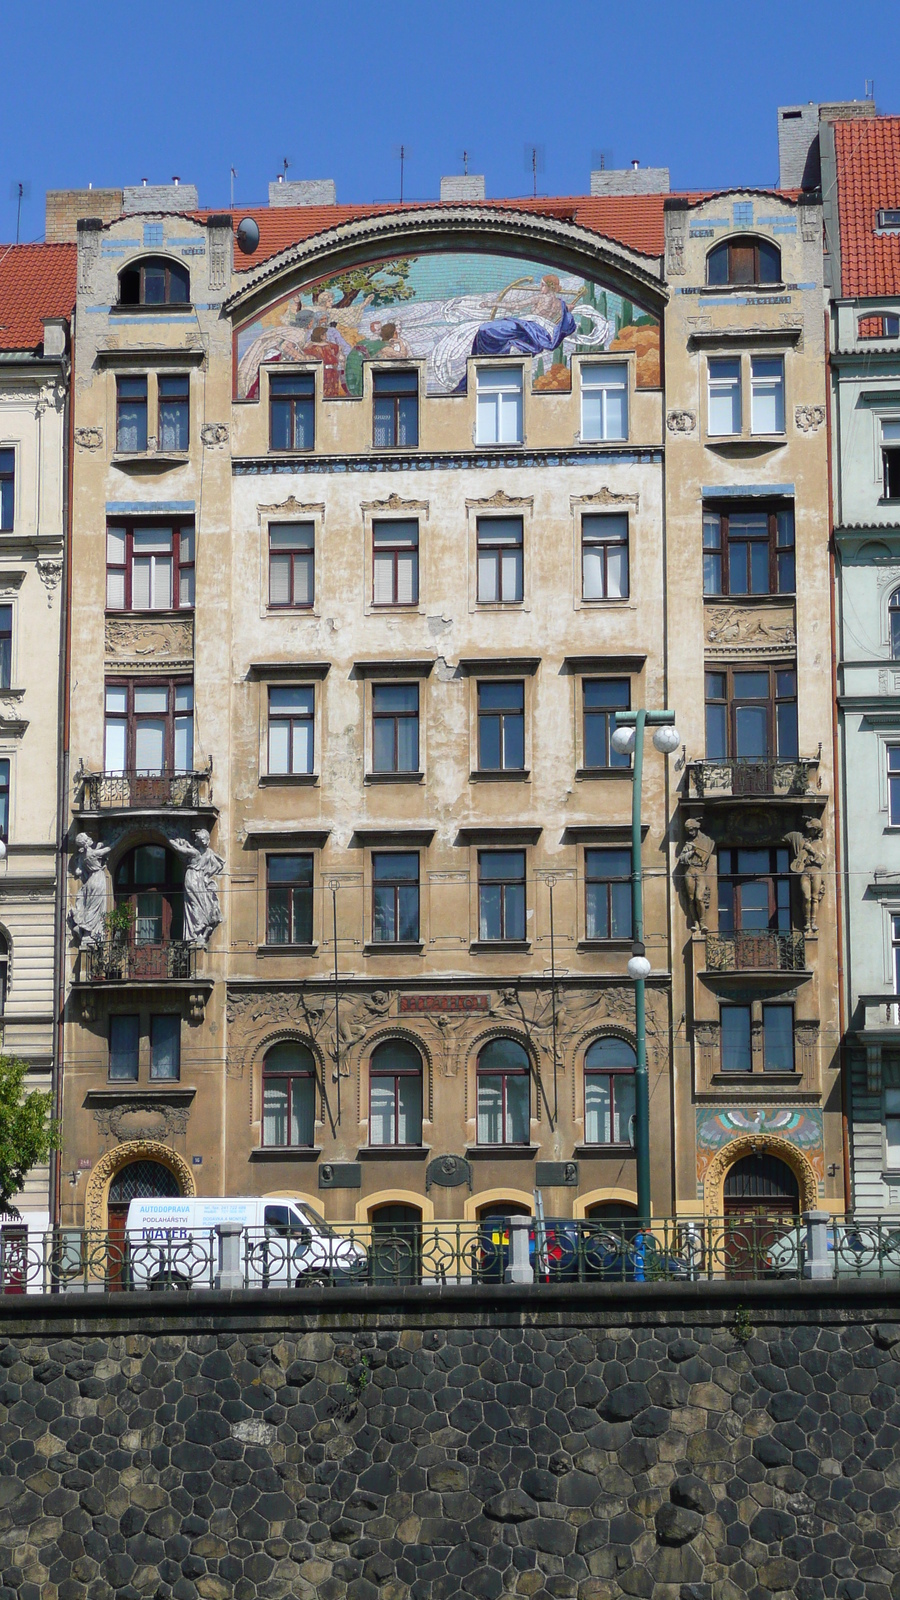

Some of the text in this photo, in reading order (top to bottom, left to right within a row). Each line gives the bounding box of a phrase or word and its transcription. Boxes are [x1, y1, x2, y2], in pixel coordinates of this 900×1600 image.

[406, 996, 486, 1009] HLAHOL
[139, 1205, 190, 1213] AUTODOPRAVA
[142, 1227, 188, 1239] MAYER
